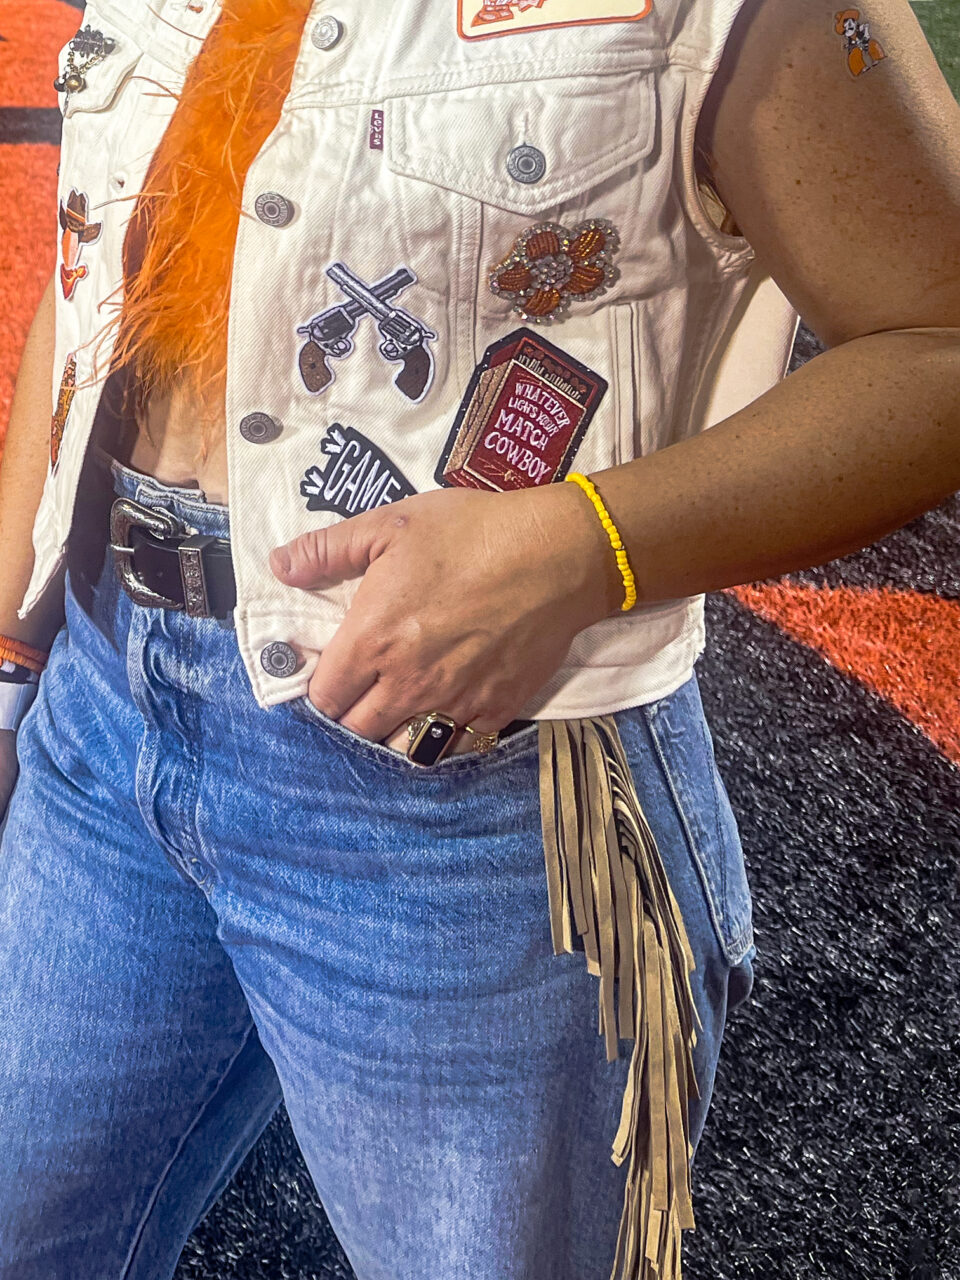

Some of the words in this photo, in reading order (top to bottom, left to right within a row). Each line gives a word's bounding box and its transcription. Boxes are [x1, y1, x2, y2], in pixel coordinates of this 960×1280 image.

[494, 408, 549, 451] MATCH
[515, 381, 570, 430] WHATEVER
[484, 430, 552, 485] COWBOY
